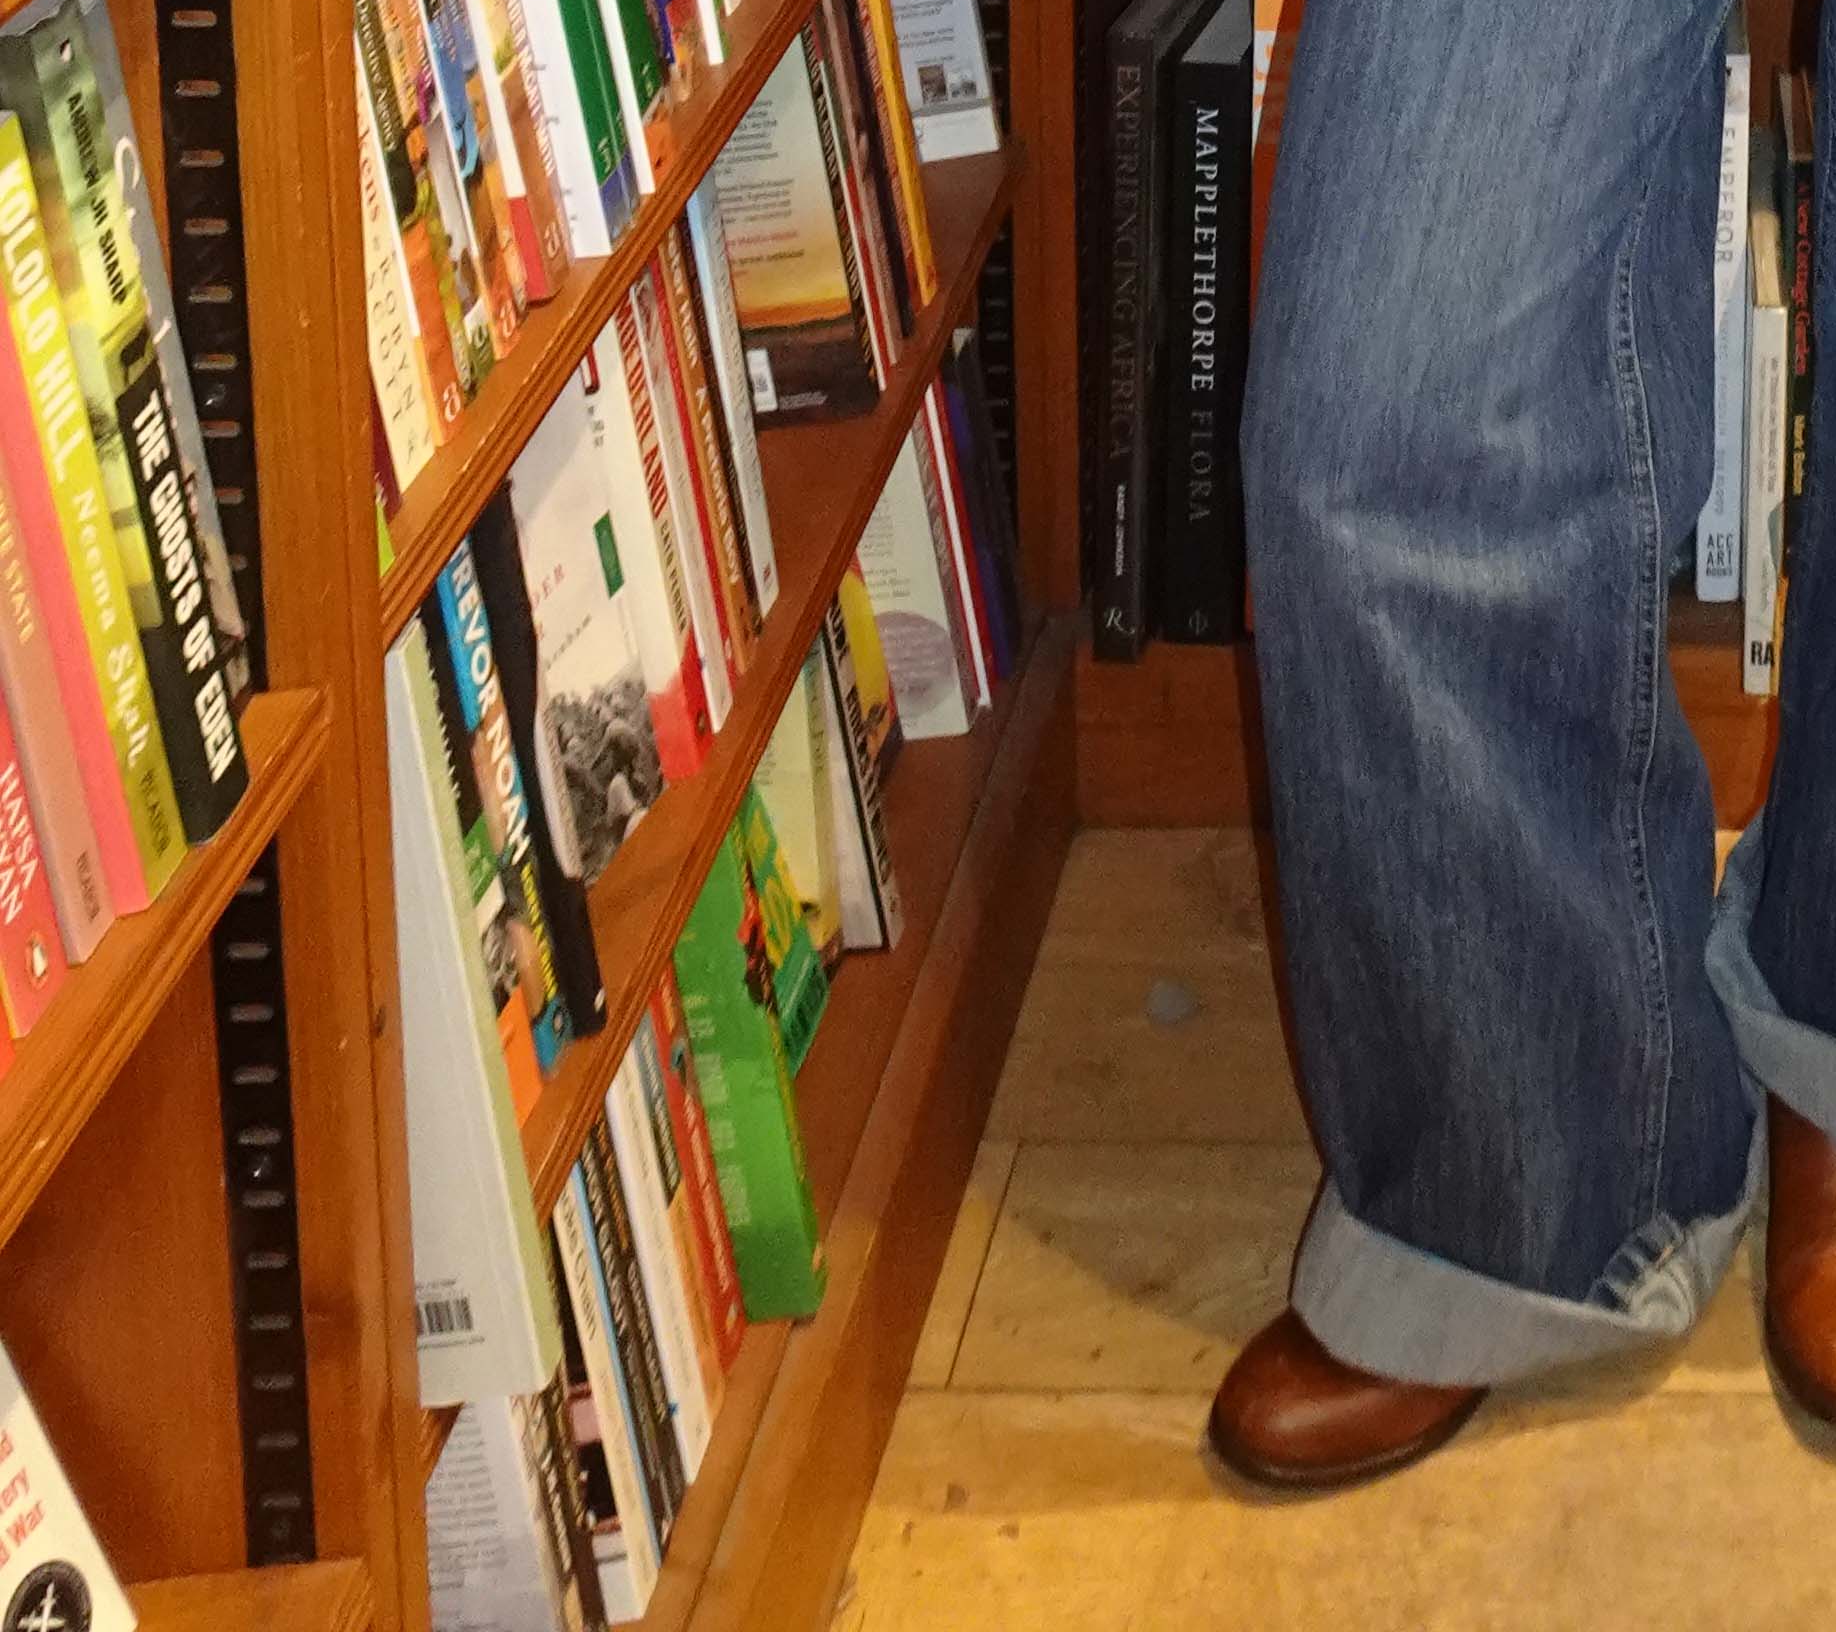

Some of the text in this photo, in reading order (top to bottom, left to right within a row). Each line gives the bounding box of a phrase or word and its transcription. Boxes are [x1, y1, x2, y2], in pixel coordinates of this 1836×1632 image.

[1191, 107, 1219, 392] MAPPLETHORPE
[132, 389, 236, 784] THE GHOSTS OF EDEN
[486, 715, 531, 864] NOAH
